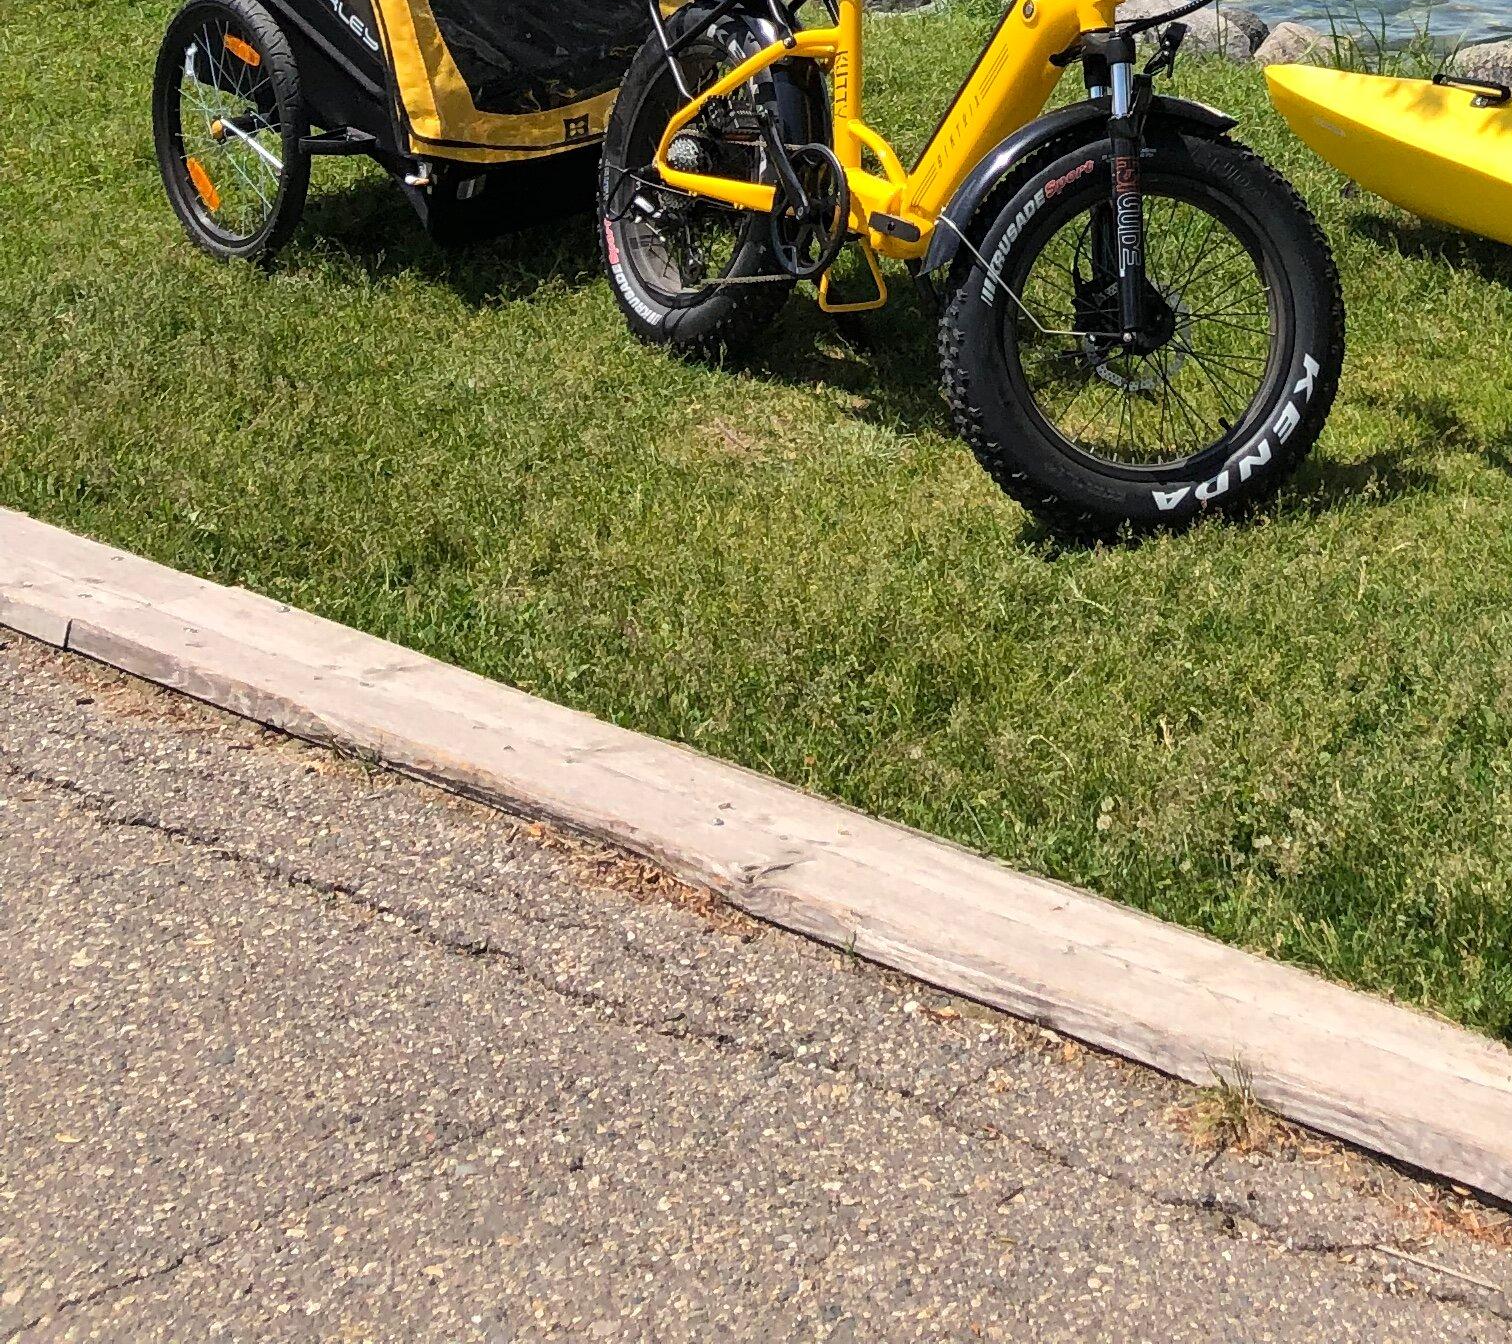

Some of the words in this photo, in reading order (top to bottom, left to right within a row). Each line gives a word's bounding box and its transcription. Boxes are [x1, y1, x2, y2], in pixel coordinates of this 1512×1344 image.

[834, 50, 849, 119] KITTY
[985, 188, 1046, 288] KRUSADE
[1044, 159, 1094, 199] Sport
[1151, 353, 1321, 511] KENDA
